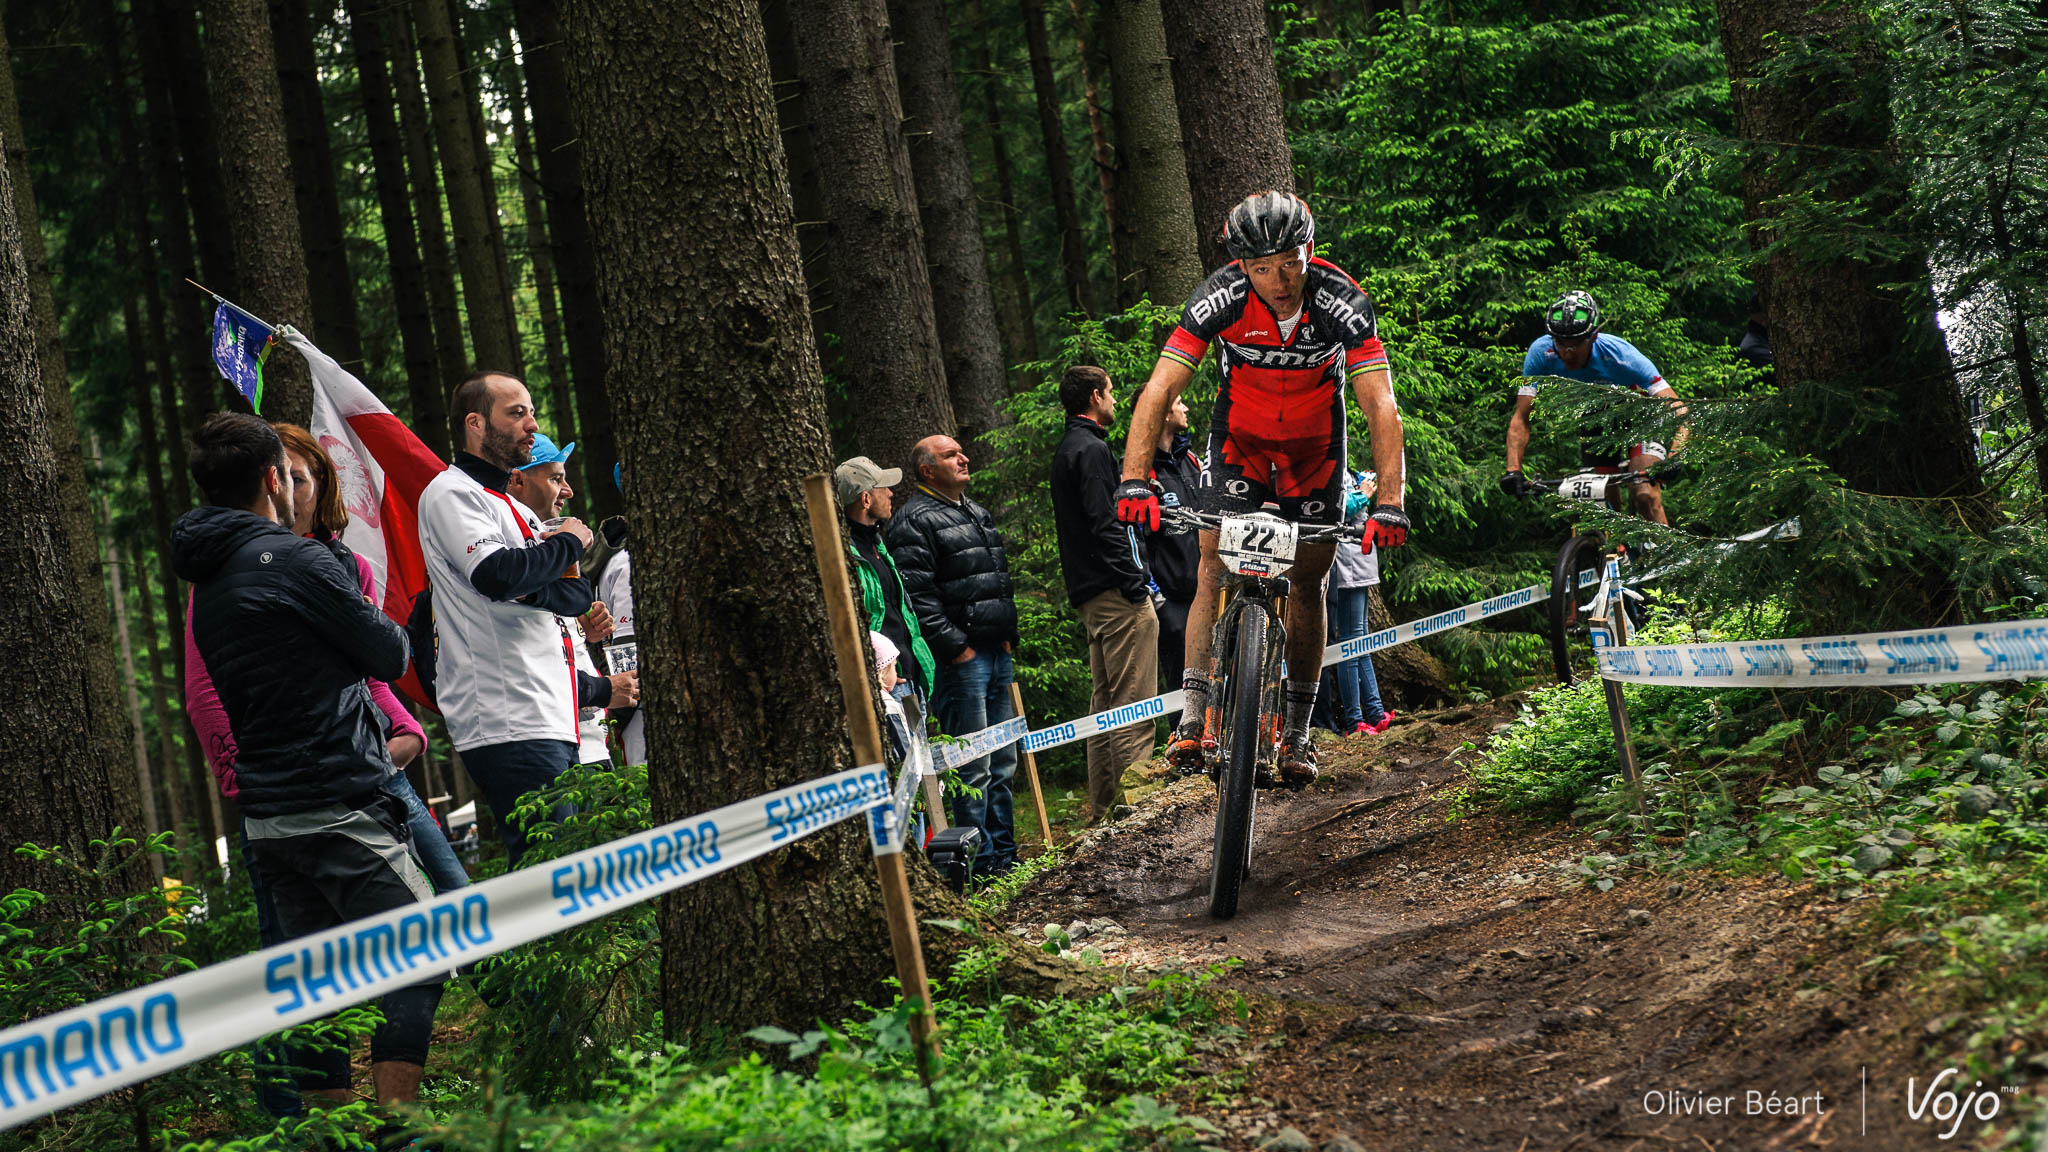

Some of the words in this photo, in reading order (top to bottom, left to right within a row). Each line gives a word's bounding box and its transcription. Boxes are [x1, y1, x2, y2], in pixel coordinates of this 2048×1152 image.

[1190, 277, 1246, 326] BMC
[1315, 286, 1370, 335] BMC
[1571, 481, 1593, 498] 35
[1240, 521, 1276, 555] 22
[1340, 629, 1397, 658] SHIMANO
[1413, 609, 1467, 637] SHIMANO
[1481, 589, 1532, 616] SHIMANO
[1096, 697, 1164, 731] SHIMANO
[0, 992, 184, 1109] MANO
[265, 893, 494, 1014] SHIMANO
[551, 820, 722, 917] SHIMANO
